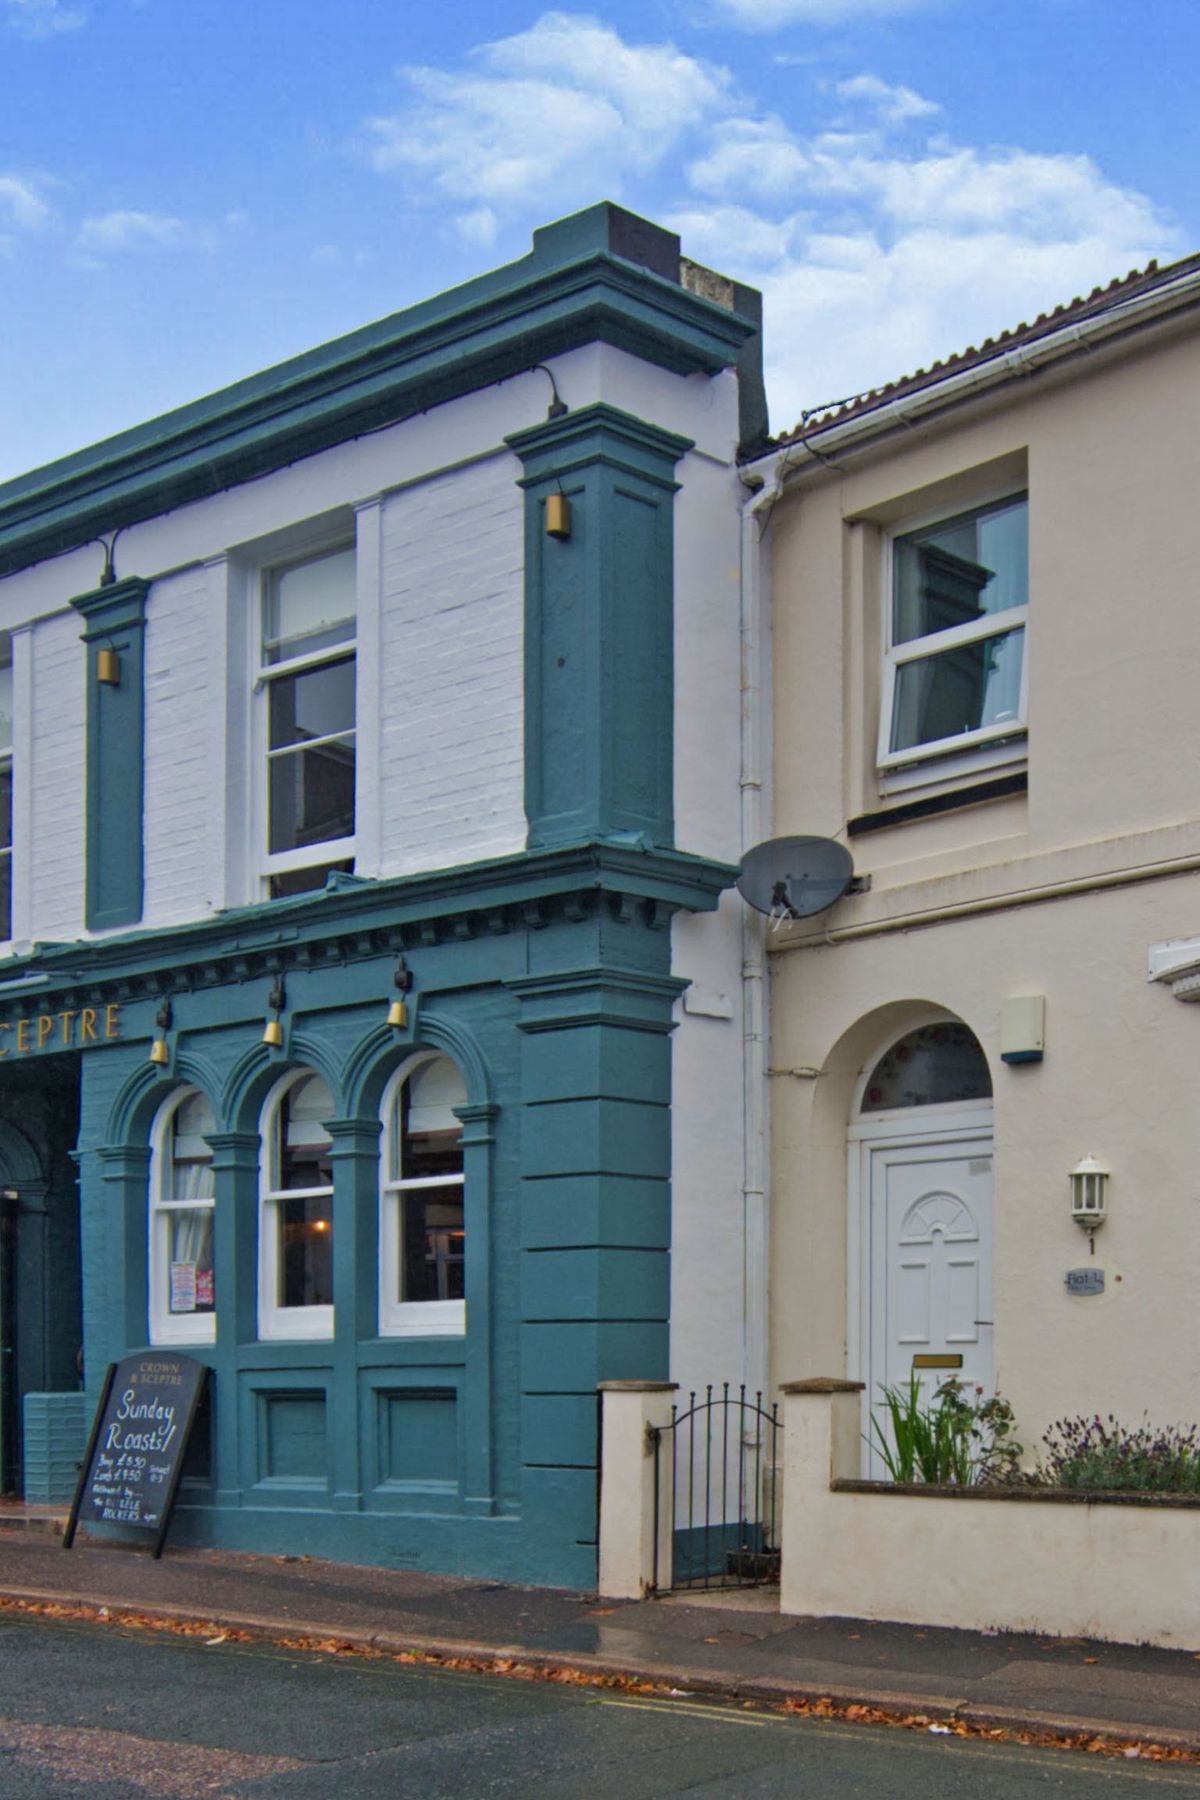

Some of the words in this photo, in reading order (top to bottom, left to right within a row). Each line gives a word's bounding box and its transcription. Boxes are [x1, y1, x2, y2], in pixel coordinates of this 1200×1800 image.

[139, 1362, 180, 1375] CROWN
[140, 1374, 182, 1385] SCEPTRE
[117, 1389, 174, 1436] Sunday
